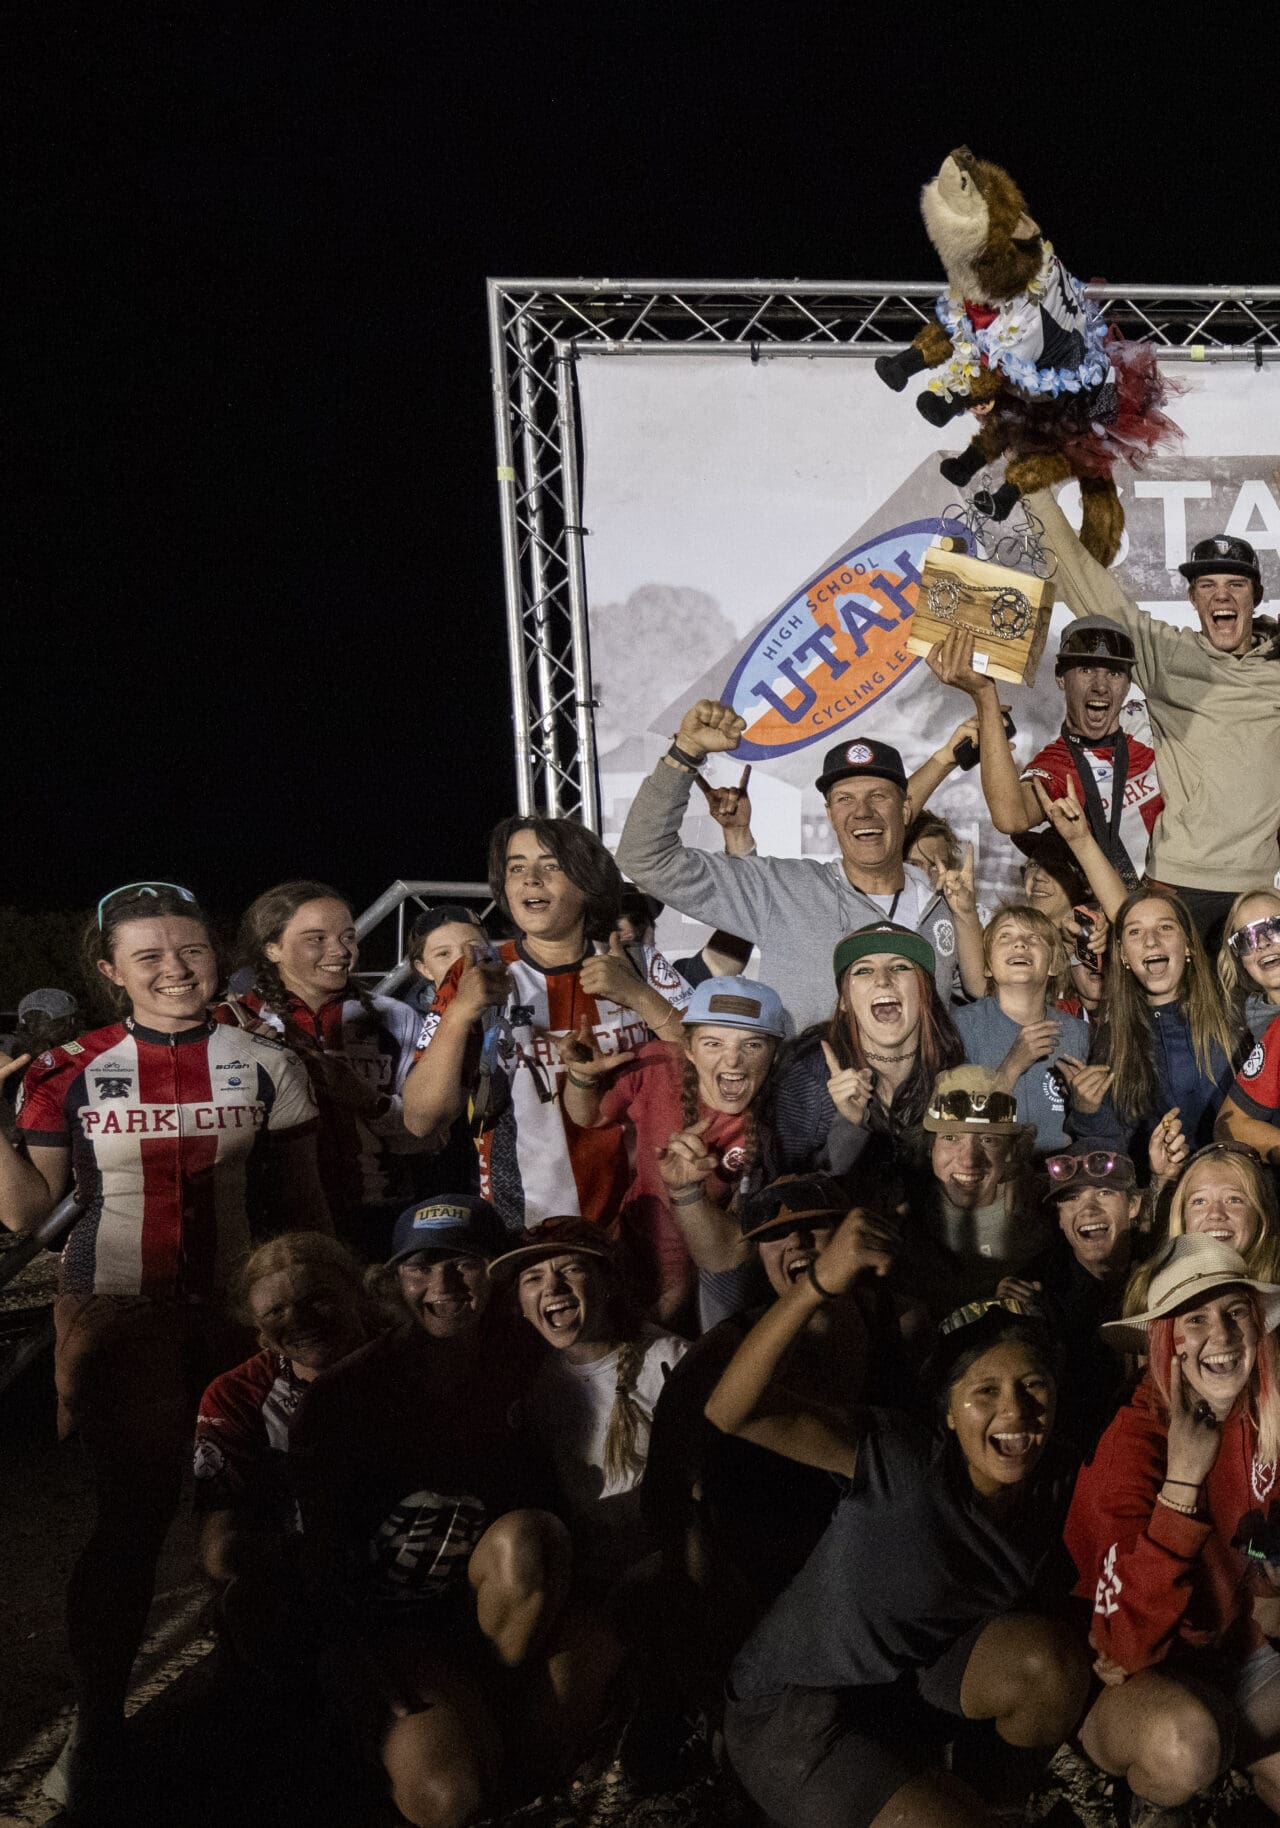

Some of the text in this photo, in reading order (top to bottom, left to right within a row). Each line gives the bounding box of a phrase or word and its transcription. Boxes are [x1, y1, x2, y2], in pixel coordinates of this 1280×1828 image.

[763, 557, 879, 661] HIGH SCHOOL
[750, 550, 922, 724] UTAH
[812, 671, 885, 726] CYCLING
[83, 1105, 266, 1135] PARK CITY
[420, 1208, 464, 1220] UTAH
